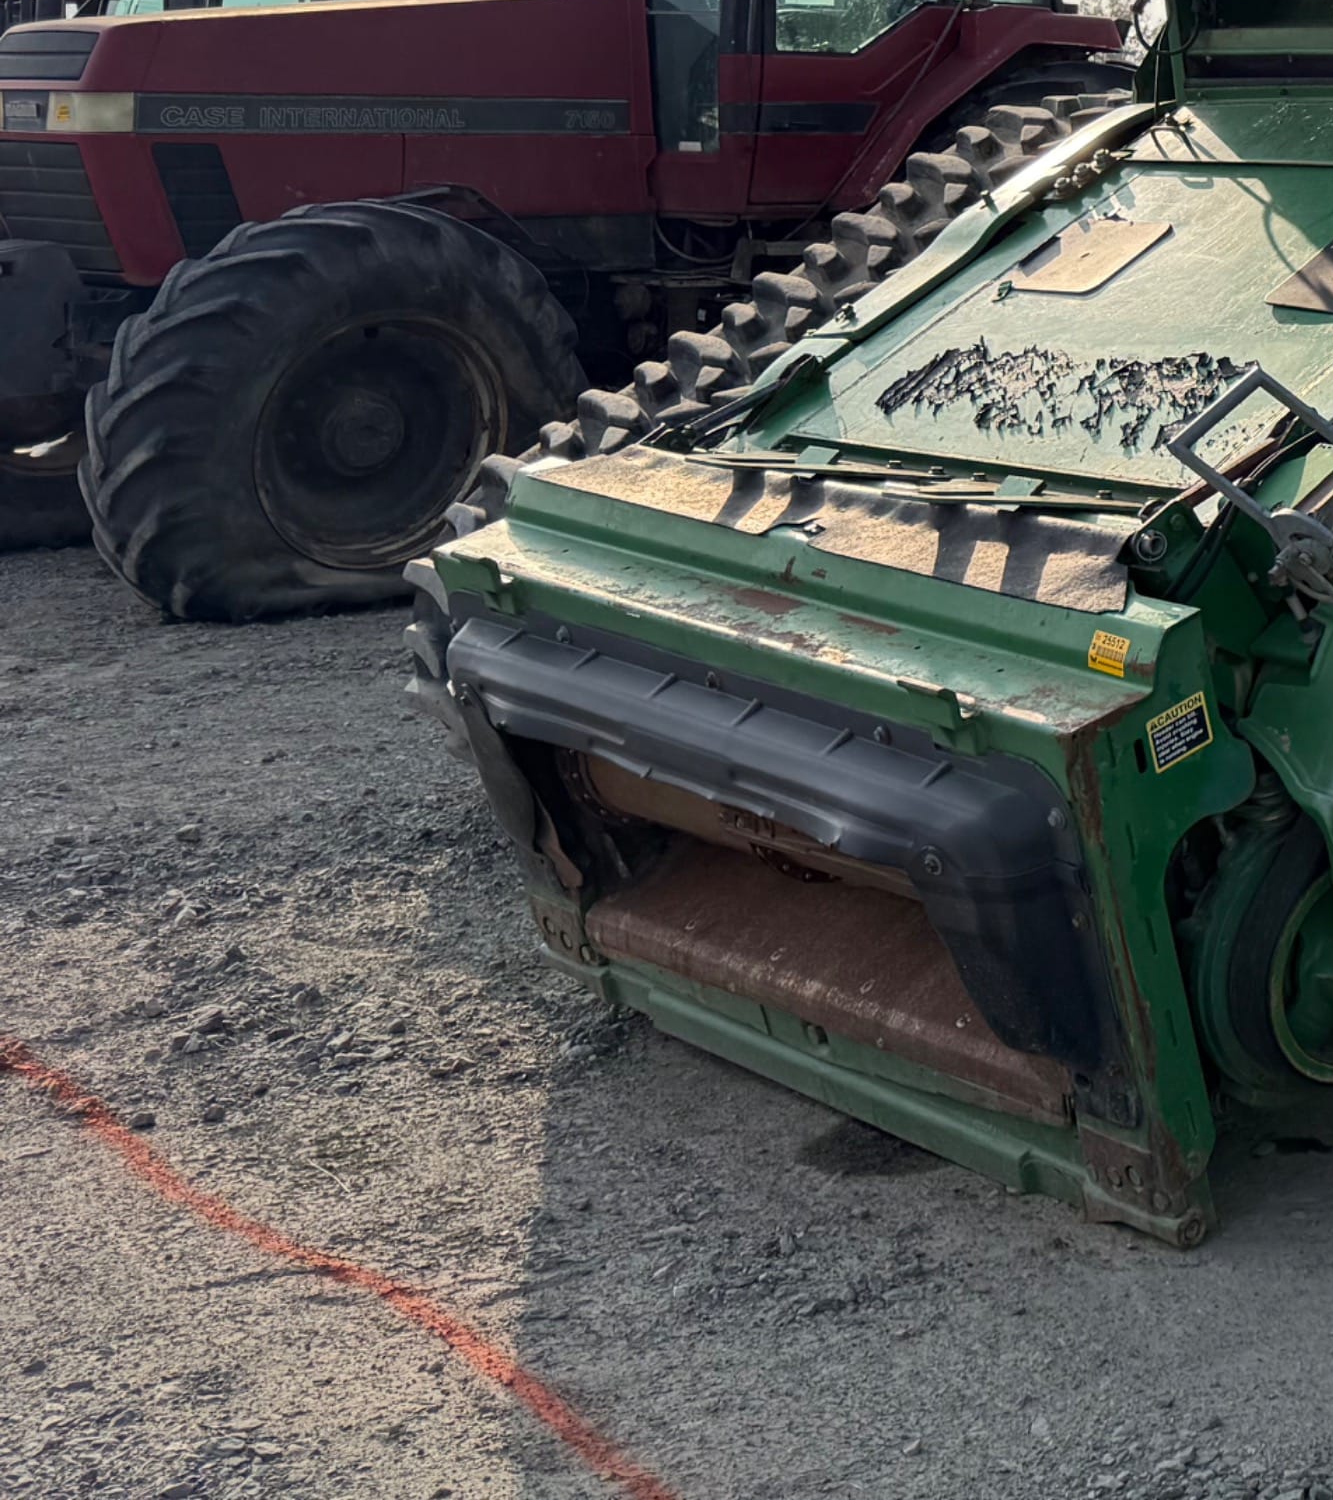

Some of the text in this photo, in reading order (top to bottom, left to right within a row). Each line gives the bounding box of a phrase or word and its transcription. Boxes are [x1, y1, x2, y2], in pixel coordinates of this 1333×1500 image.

[160, 105, 245, 128] CASE
[259, 107, 465, 128] INTERNATIONAL
[1157, 694, 1202, 726] CAUTION
